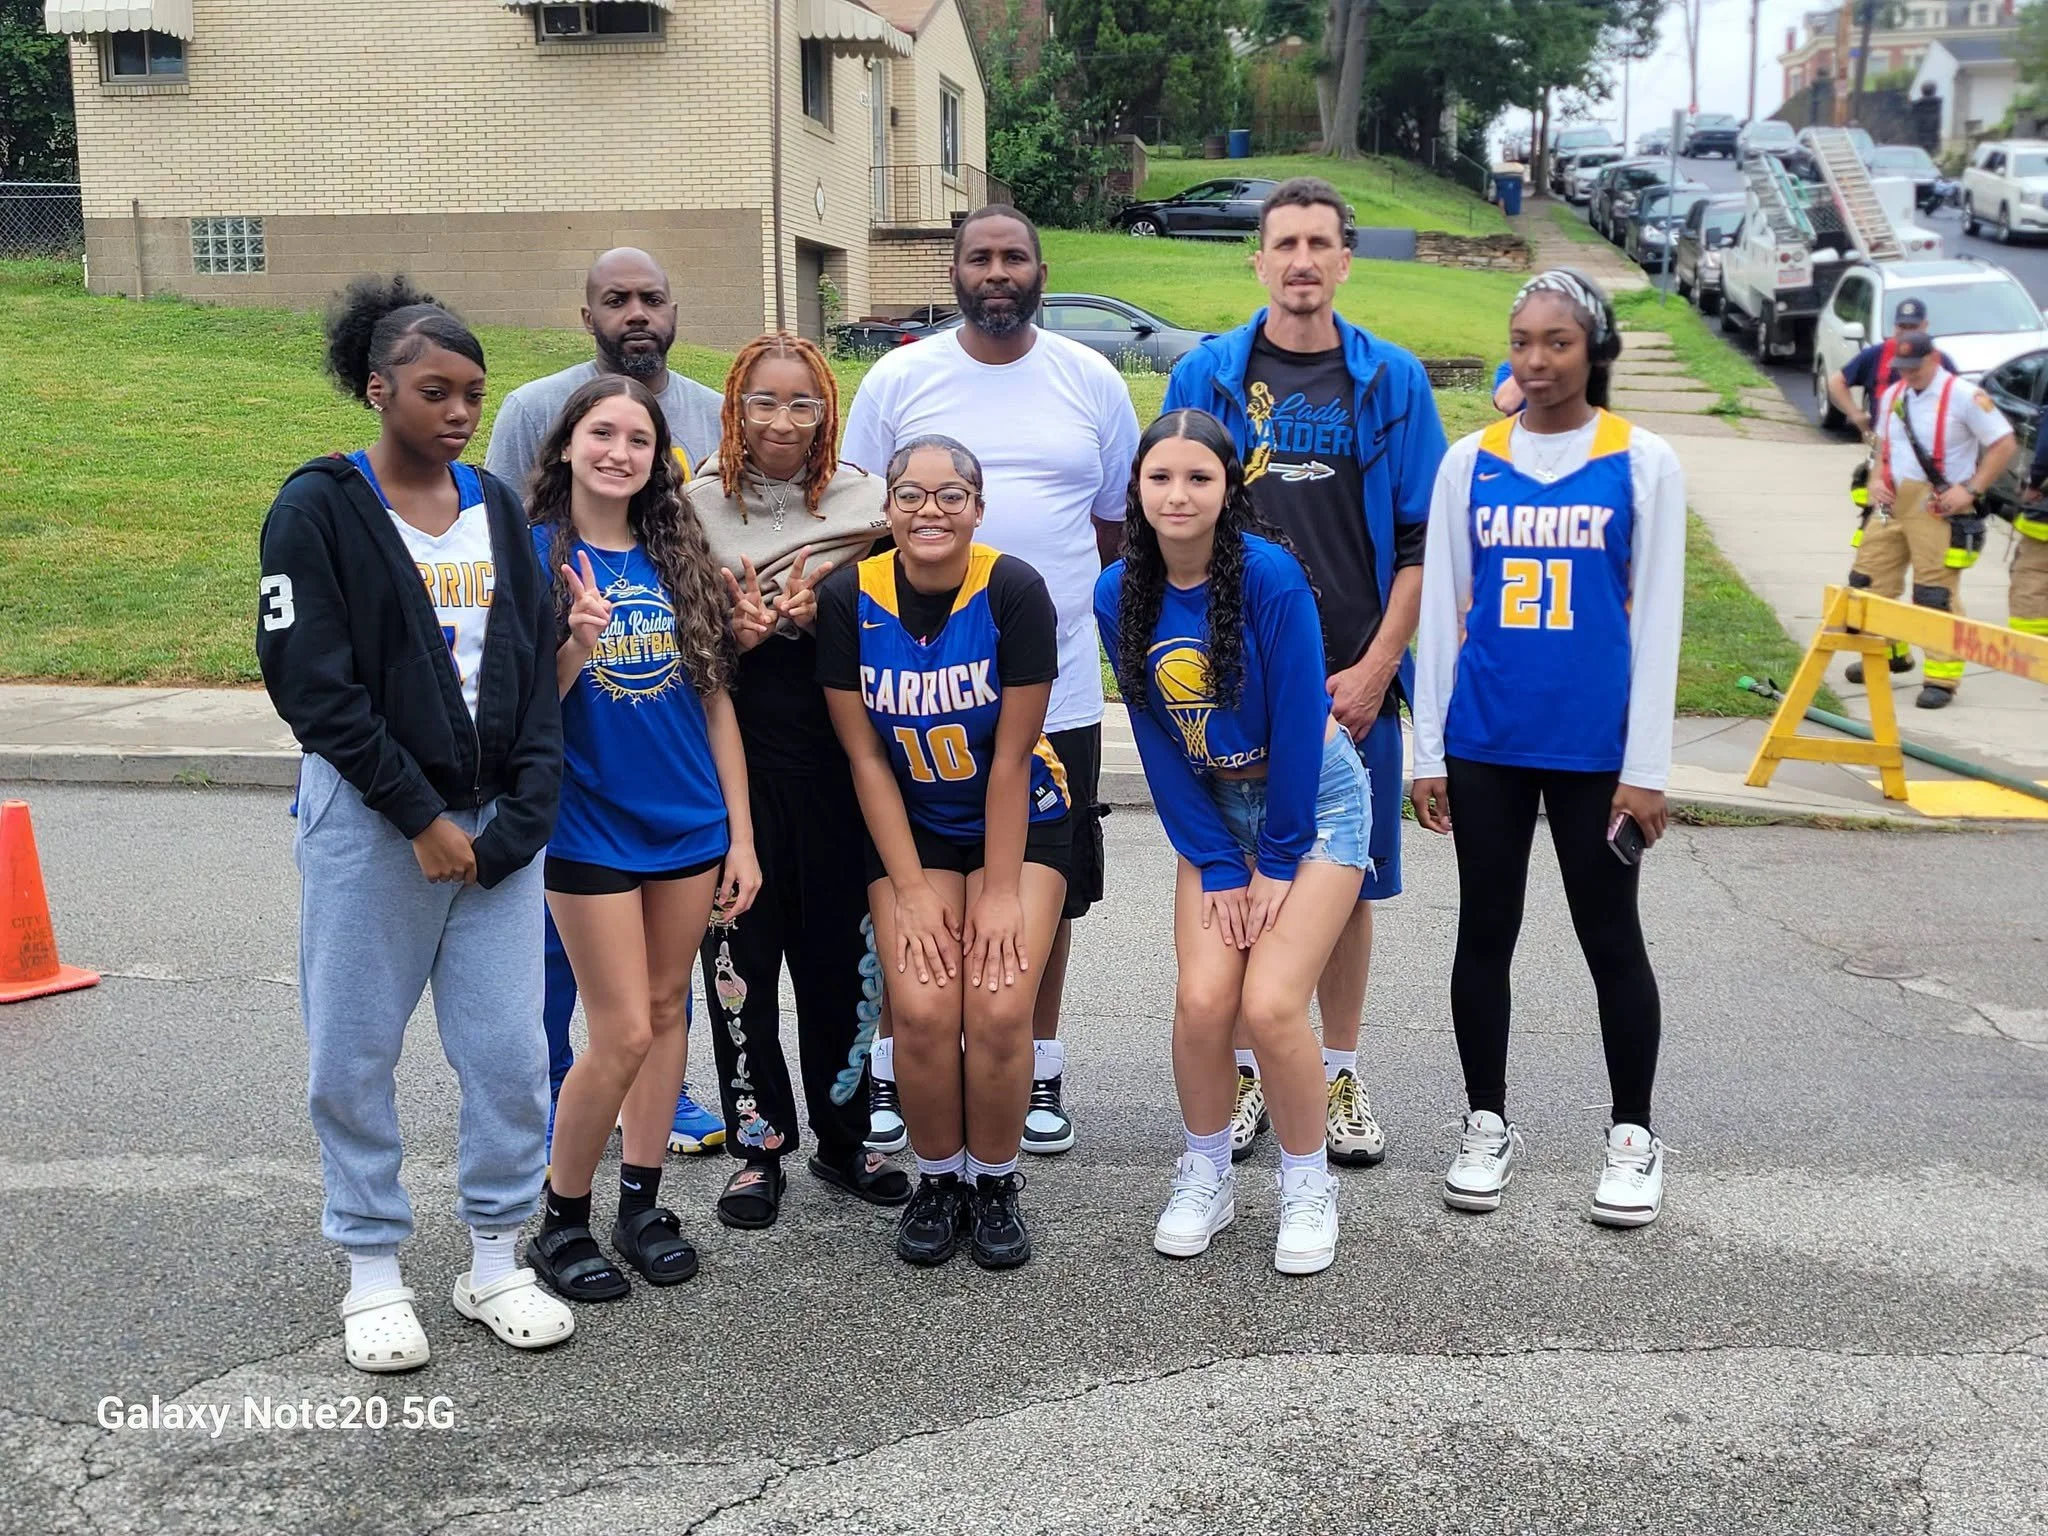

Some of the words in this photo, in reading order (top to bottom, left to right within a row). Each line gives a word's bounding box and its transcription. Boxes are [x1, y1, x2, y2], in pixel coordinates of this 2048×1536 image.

[1272, 392, 1350, 427] Lady
[1476, 504, 1615, 551] CARRICK
[260, 573, 296, 632] 3
[415, 561, 495, 608] RRIC
[1499, 557, 1575, 631] 21
[629, 608, 676, 637] Raider
[586, 631, 680, 664] ASKETBA
[860, 658, 999, 717] CARRICK
[893, 723, 978, 783] 10
[1035, 786, 1046, 797] M
